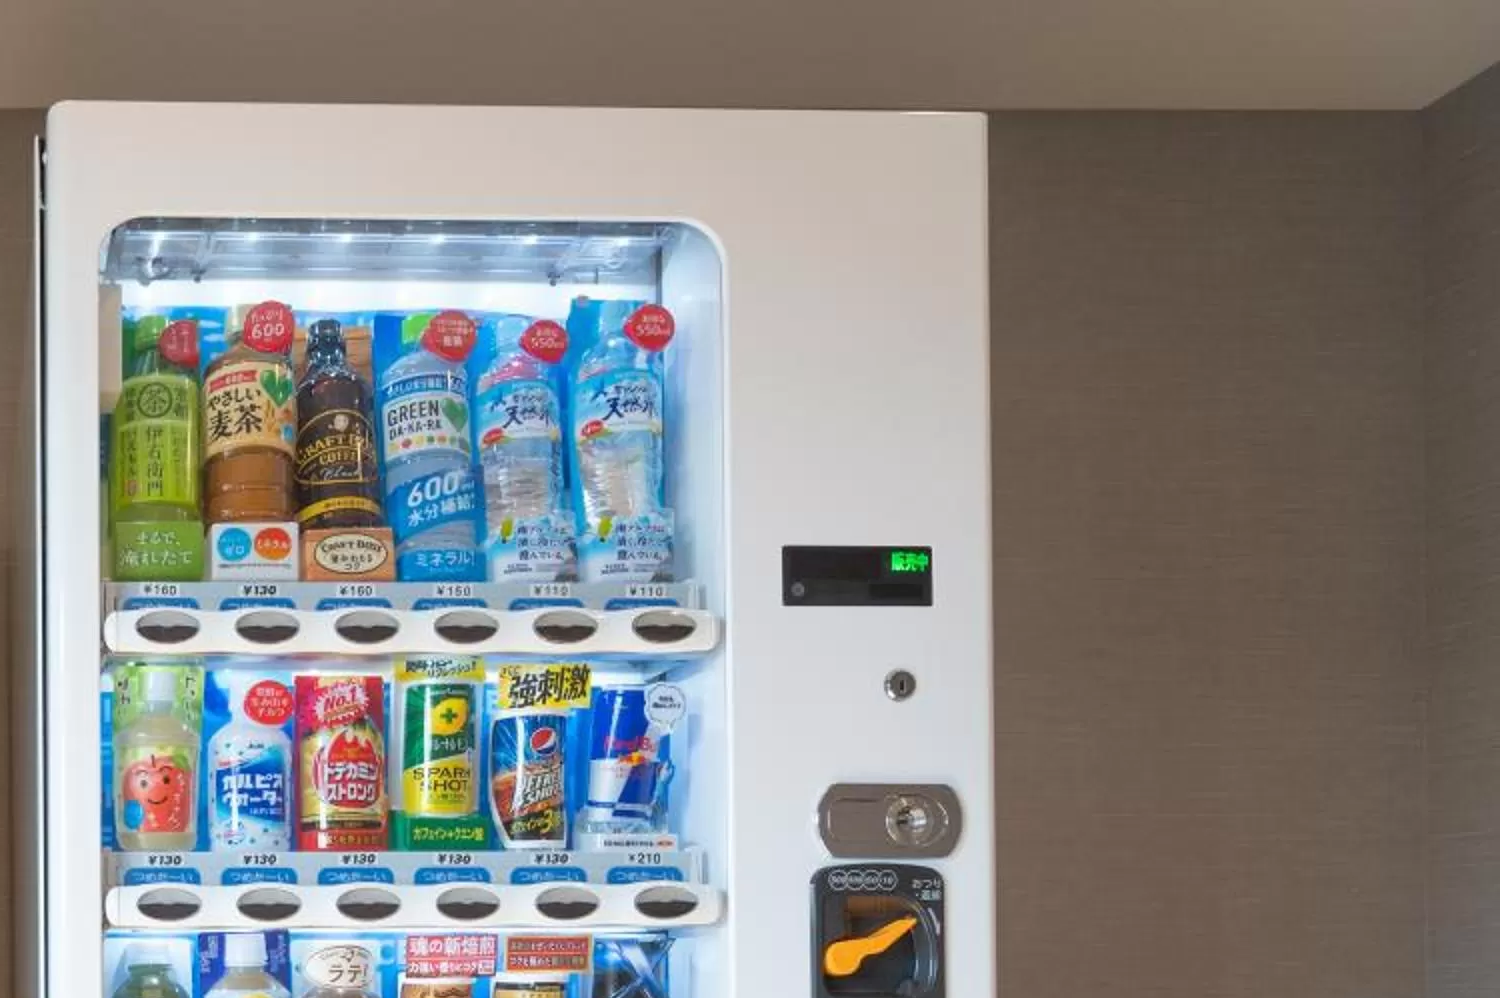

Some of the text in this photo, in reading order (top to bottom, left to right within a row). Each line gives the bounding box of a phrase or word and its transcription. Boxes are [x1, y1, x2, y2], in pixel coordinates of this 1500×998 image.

[252, 323, 285, 339] 600
[208, 387, 262, 410] やさしい
[387, 400, 440, 427] GREEN
[210, 404, 262, 443] 麦茶
[243, 585, 277, 595] ¥130
[509, 664, 591, 708] 強刺激
[222, 773, 283, 790] カルピス
[327, 782, 375, 800] ストロング
[148, 856, 181, 865] ¥130
[244, 855, 276, 865] ¥130
[343, 855, 376, 864] ¥130
[438, 855, 471, 864] ¥130
[534, 855, 568, 864] ¥130
[629, 854, 661, 864] ¥210
